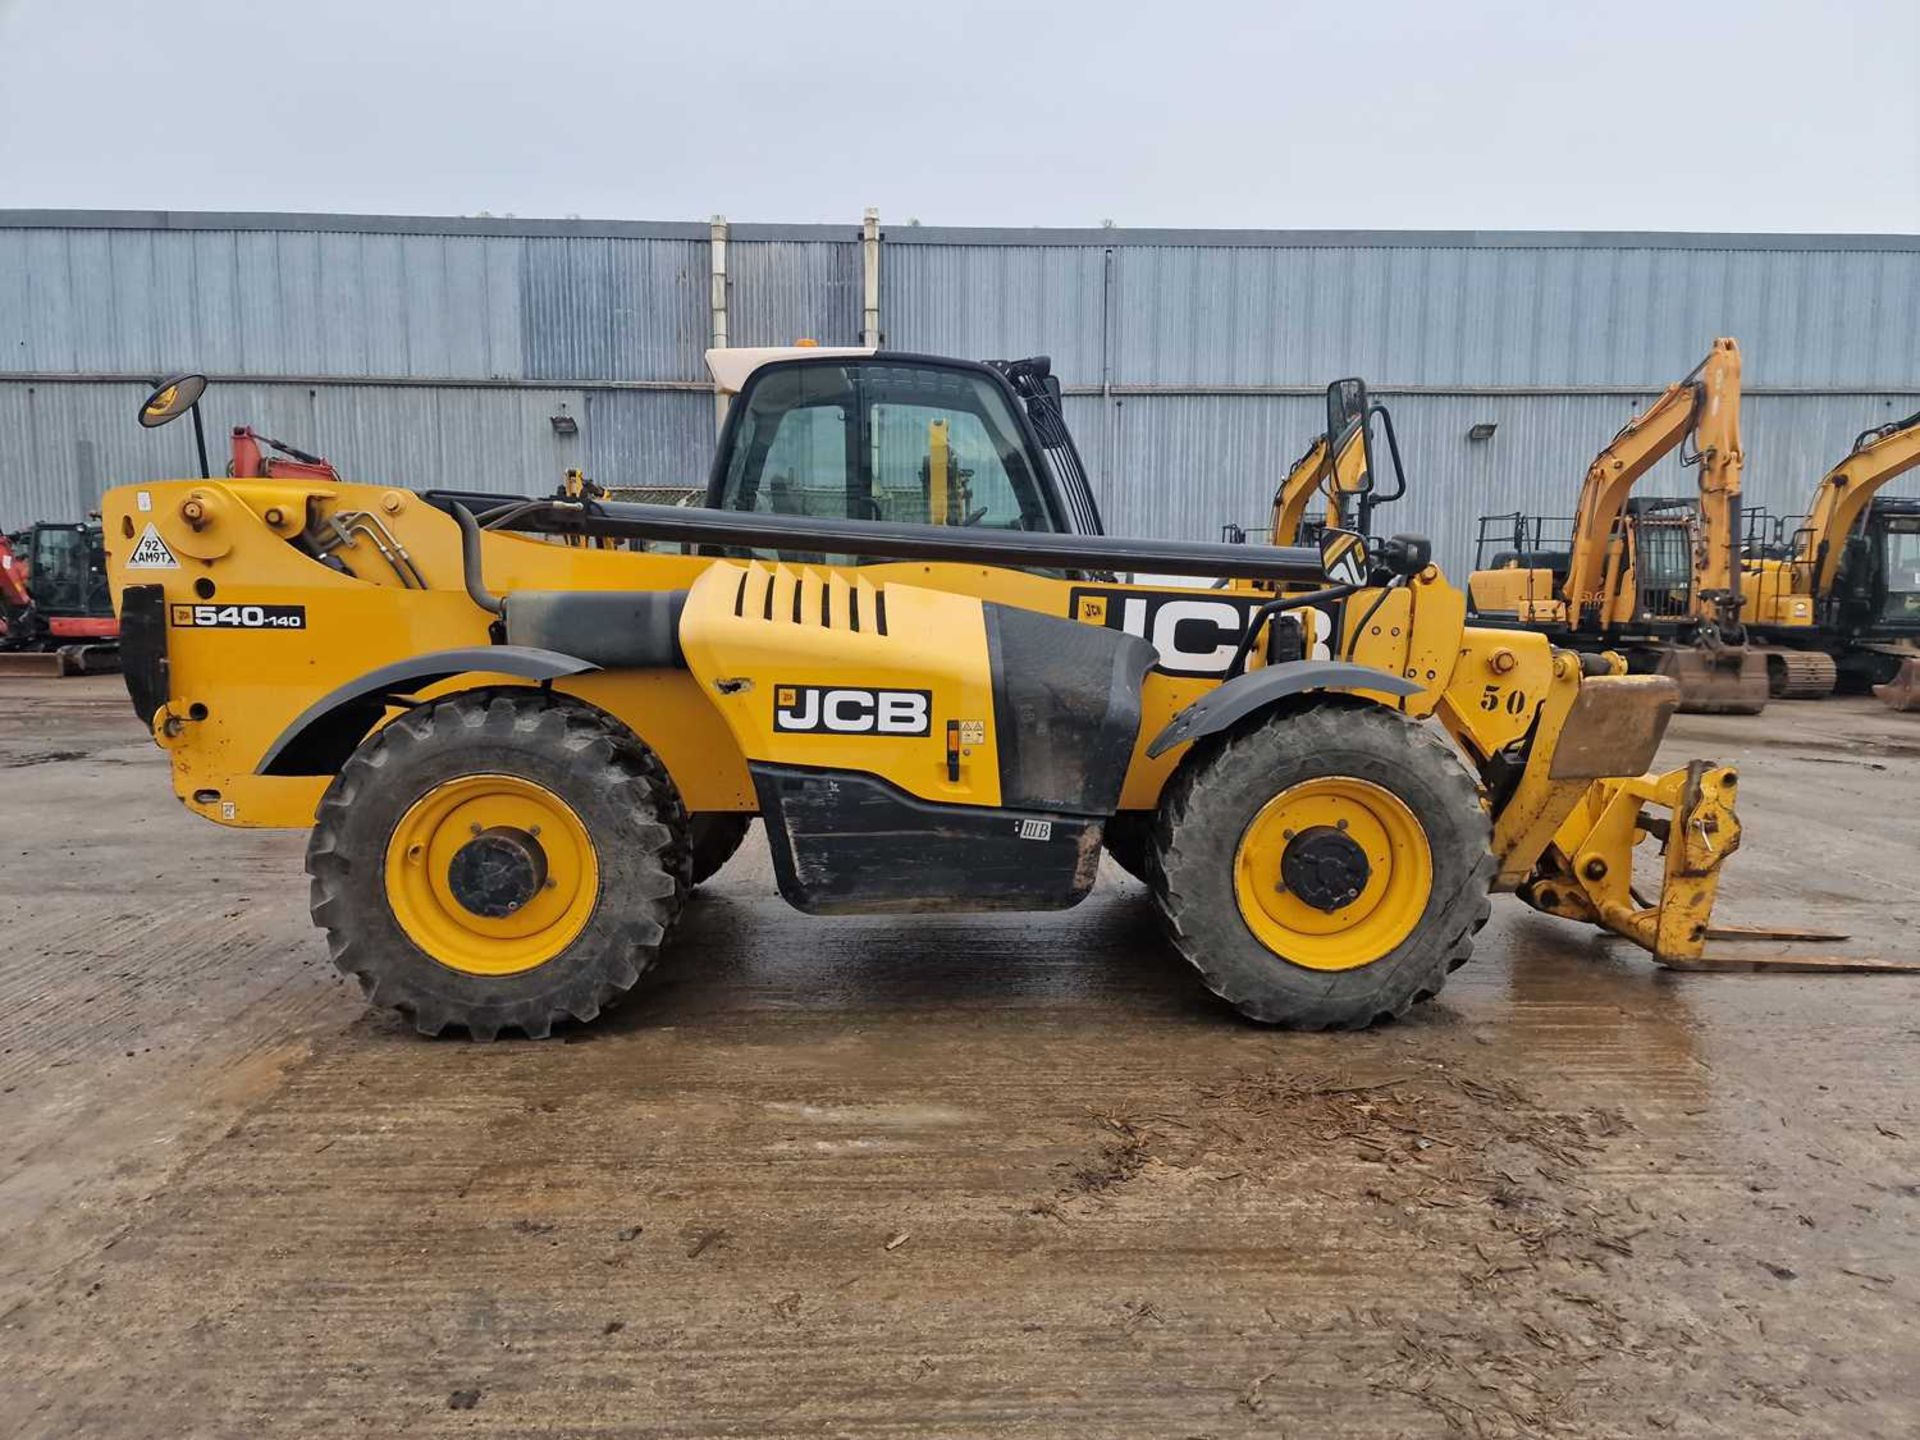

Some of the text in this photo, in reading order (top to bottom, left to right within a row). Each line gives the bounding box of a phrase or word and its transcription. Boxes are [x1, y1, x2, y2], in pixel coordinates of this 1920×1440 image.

[145, 540, 158, 551] 92
[139, 552, 166, 563] AM9T
[195, 606, 300, 627] 540-140
[1481, 685, 1525, 714] 50
[777, 689, 928, 732] JCB
